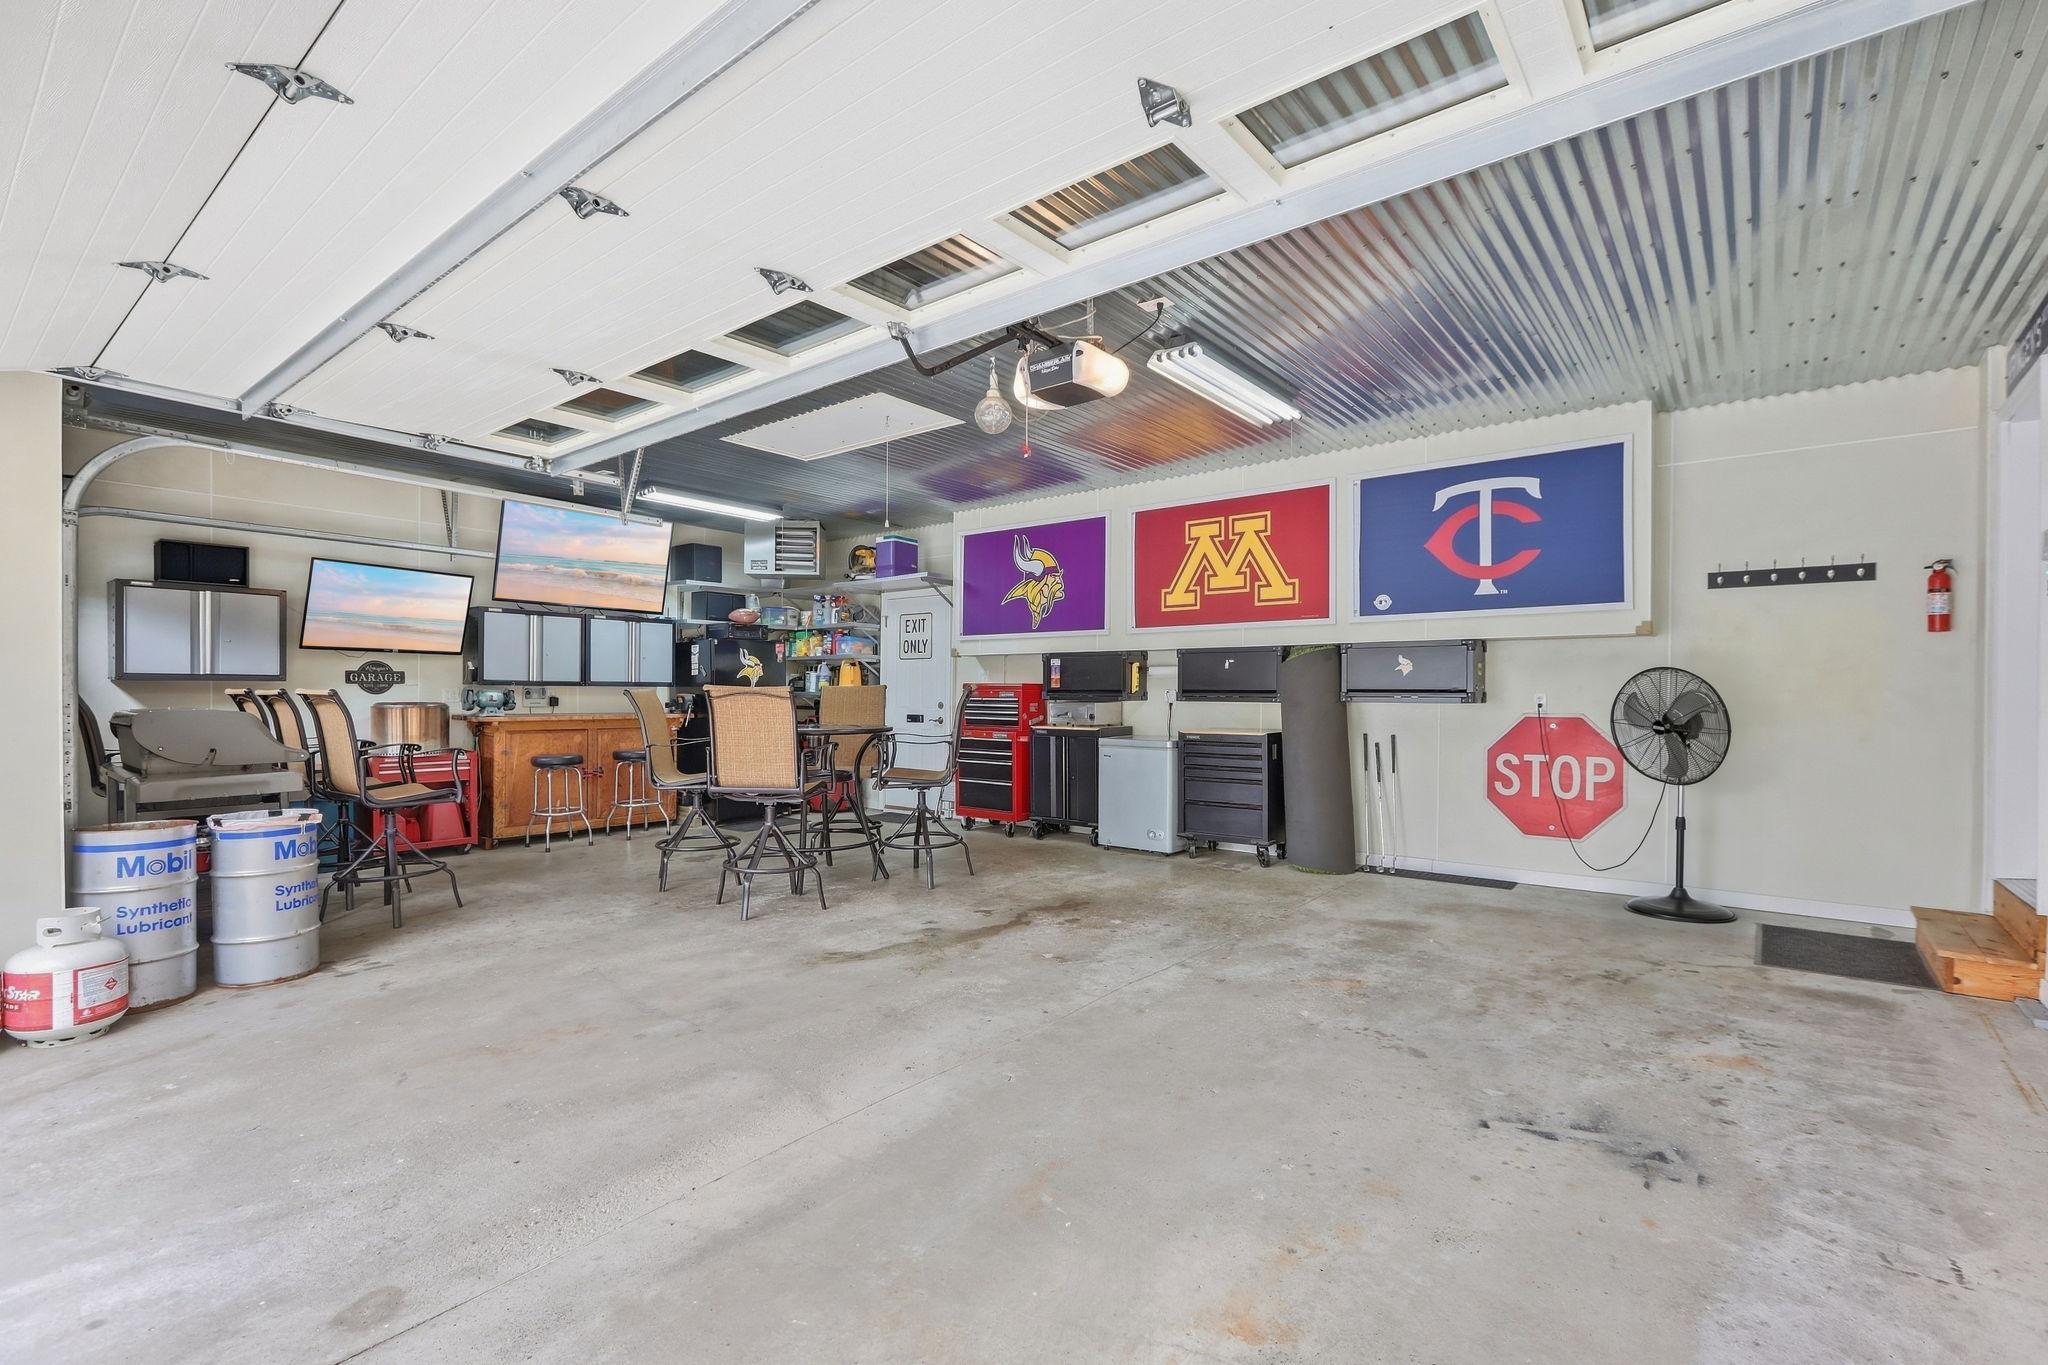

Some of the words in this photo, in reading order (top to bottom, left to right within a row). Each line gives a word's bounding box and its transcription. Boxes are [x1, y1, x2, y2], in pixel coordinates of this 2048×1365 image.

[1161, 511, 1299, 611] M
[905, 618, 927, 633] EXIT
[903, 639, 929, 654] ONLY
[350, 673, 401, 682] GARAGE
[1494, 752, 1616, 801] STOP
[116, 849, 192, 879] Mobil
[116, 897, 192, 920] Synthetic
[116, 912, 192, 936] Lubricant
